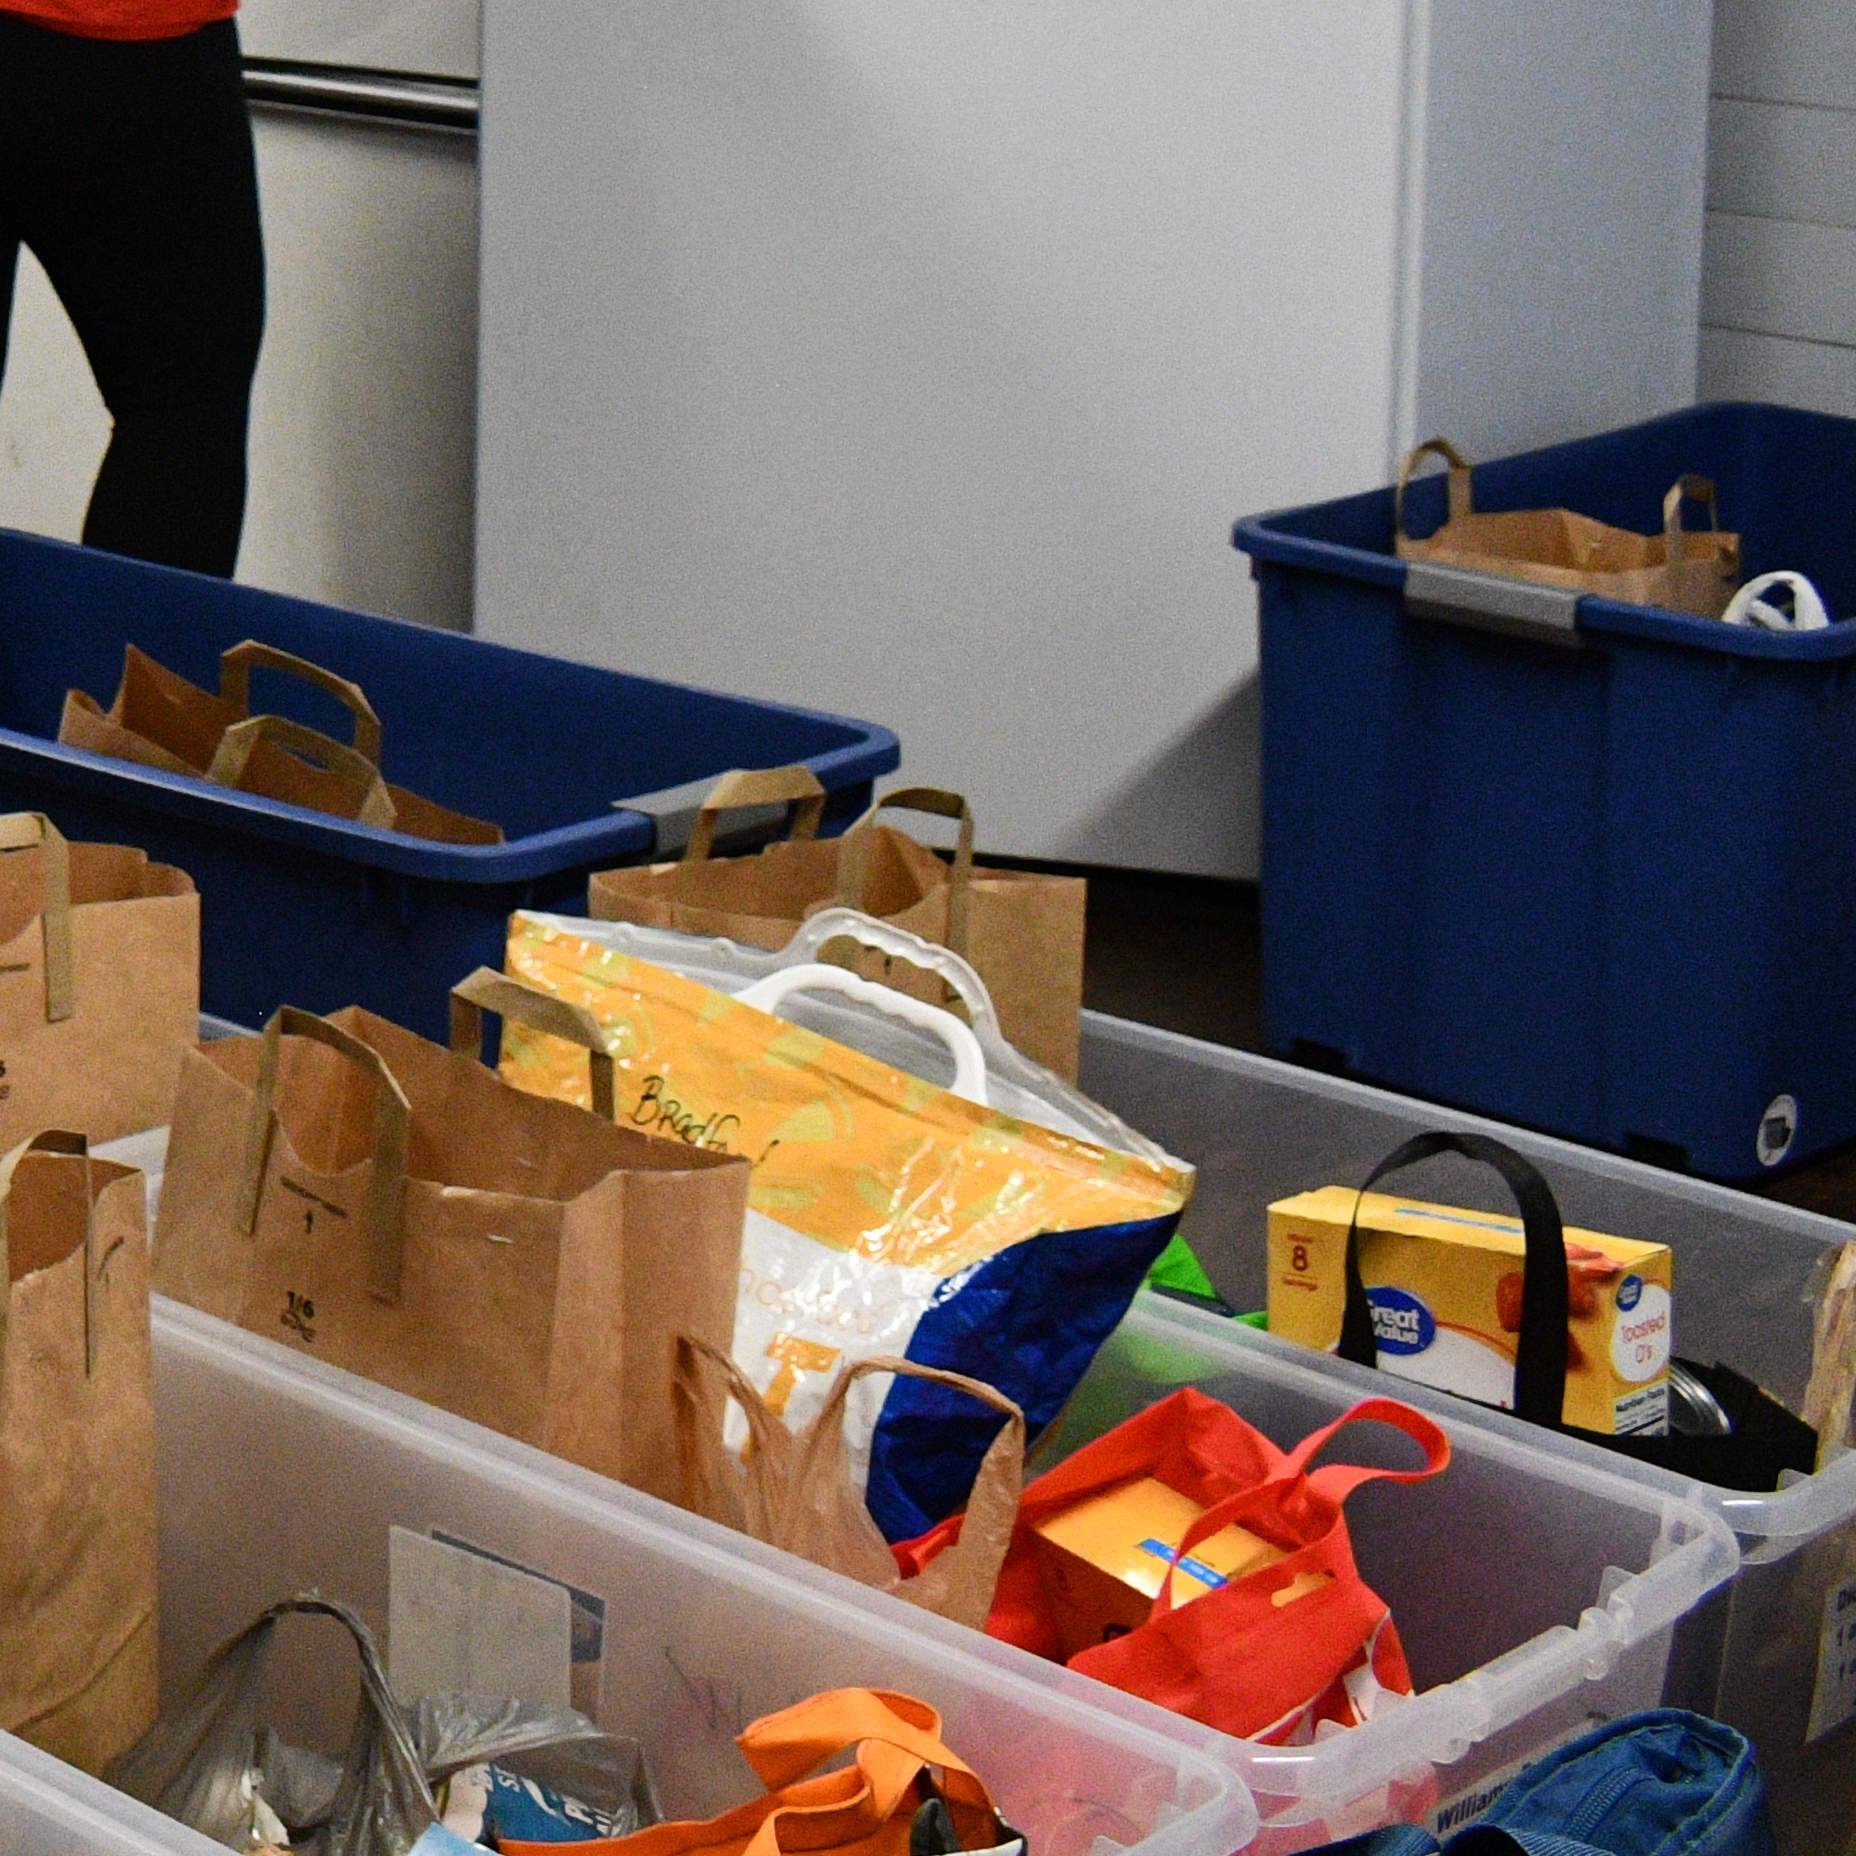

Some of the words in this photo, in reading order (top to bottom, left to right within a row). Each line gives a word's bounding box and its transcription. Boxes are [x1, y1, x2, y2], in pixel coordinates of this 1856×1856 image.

[1291, 1245, 1308, 1271] 8
[1367, 1299, 1420, 1331] reat
[1621, 1309, 1667, 1344] Toasted
